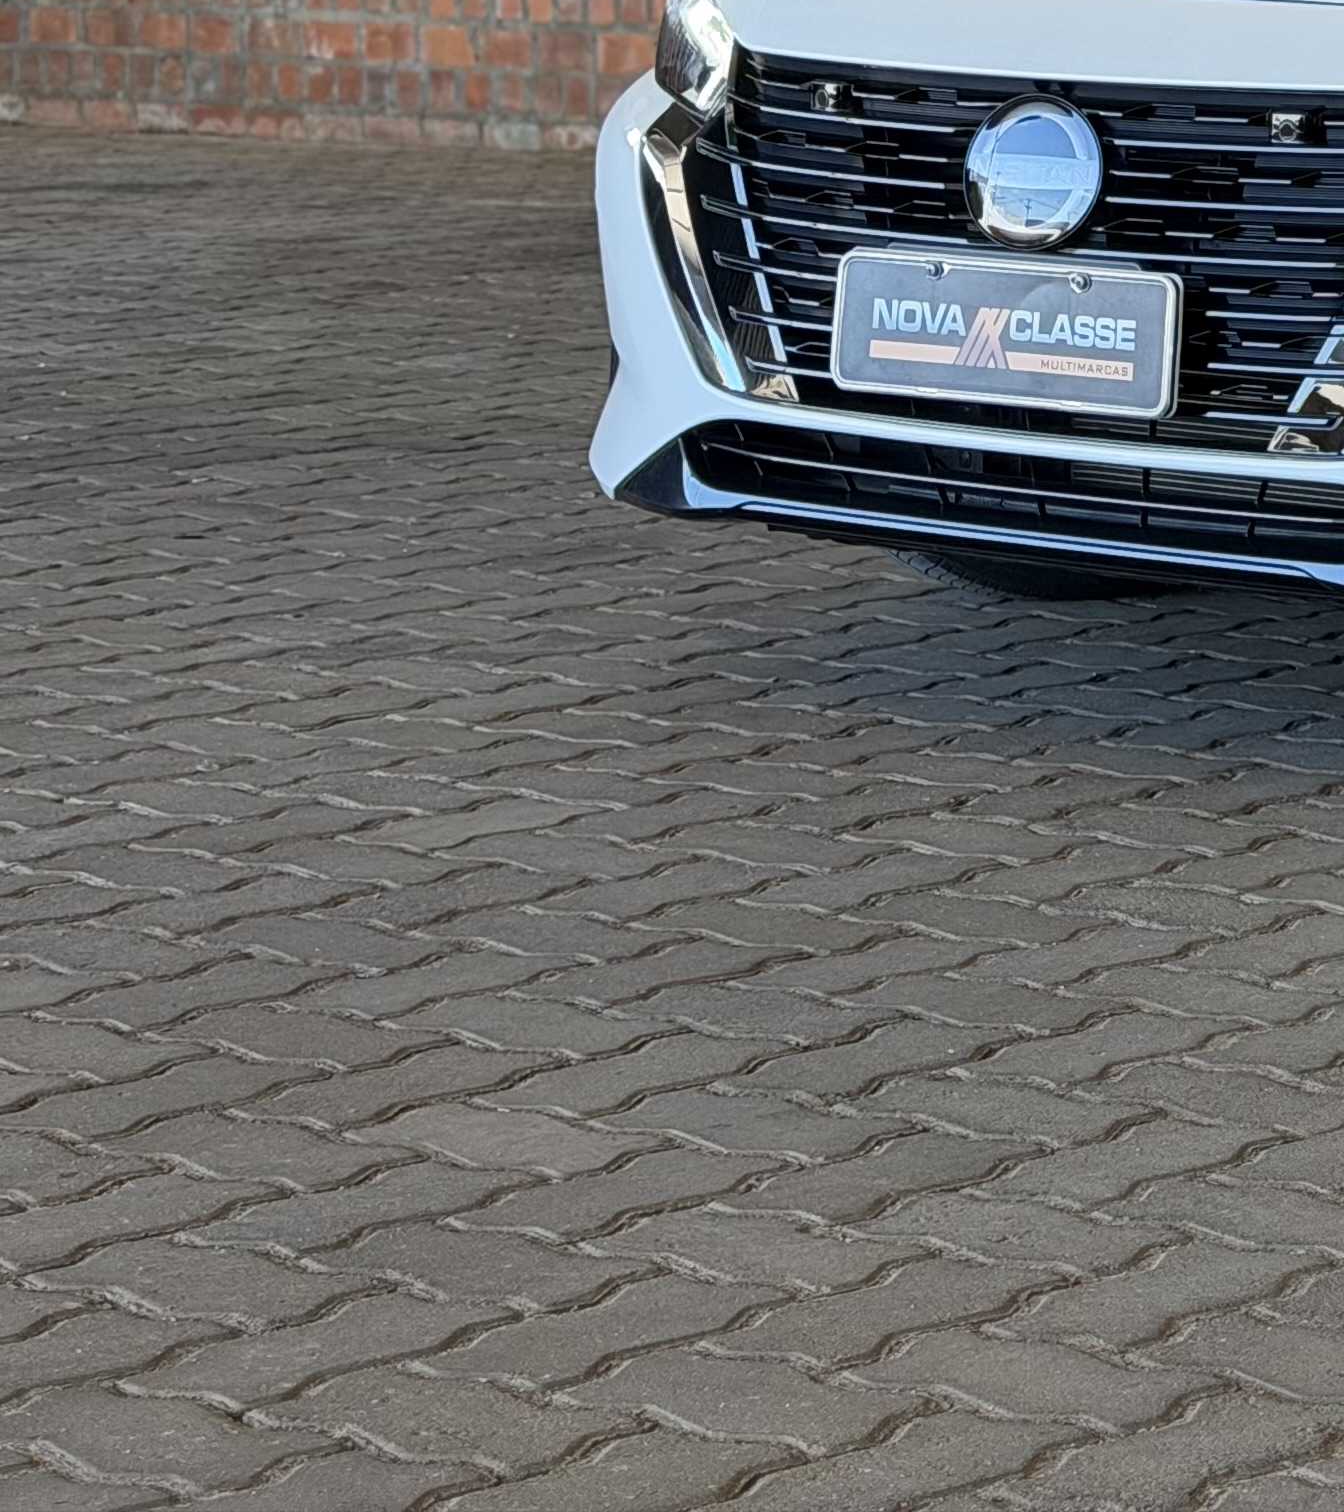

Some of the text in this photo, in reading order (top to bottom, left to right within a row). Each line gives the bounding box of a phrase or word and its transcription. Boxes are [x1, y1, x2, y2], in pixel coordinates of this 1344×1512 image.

[968, 157, 1096, 187] NSAN
[872, 297, 1137, 352] NOVA CLASSE
[1039, 358, 1129, 377] MULTIMARCAS
